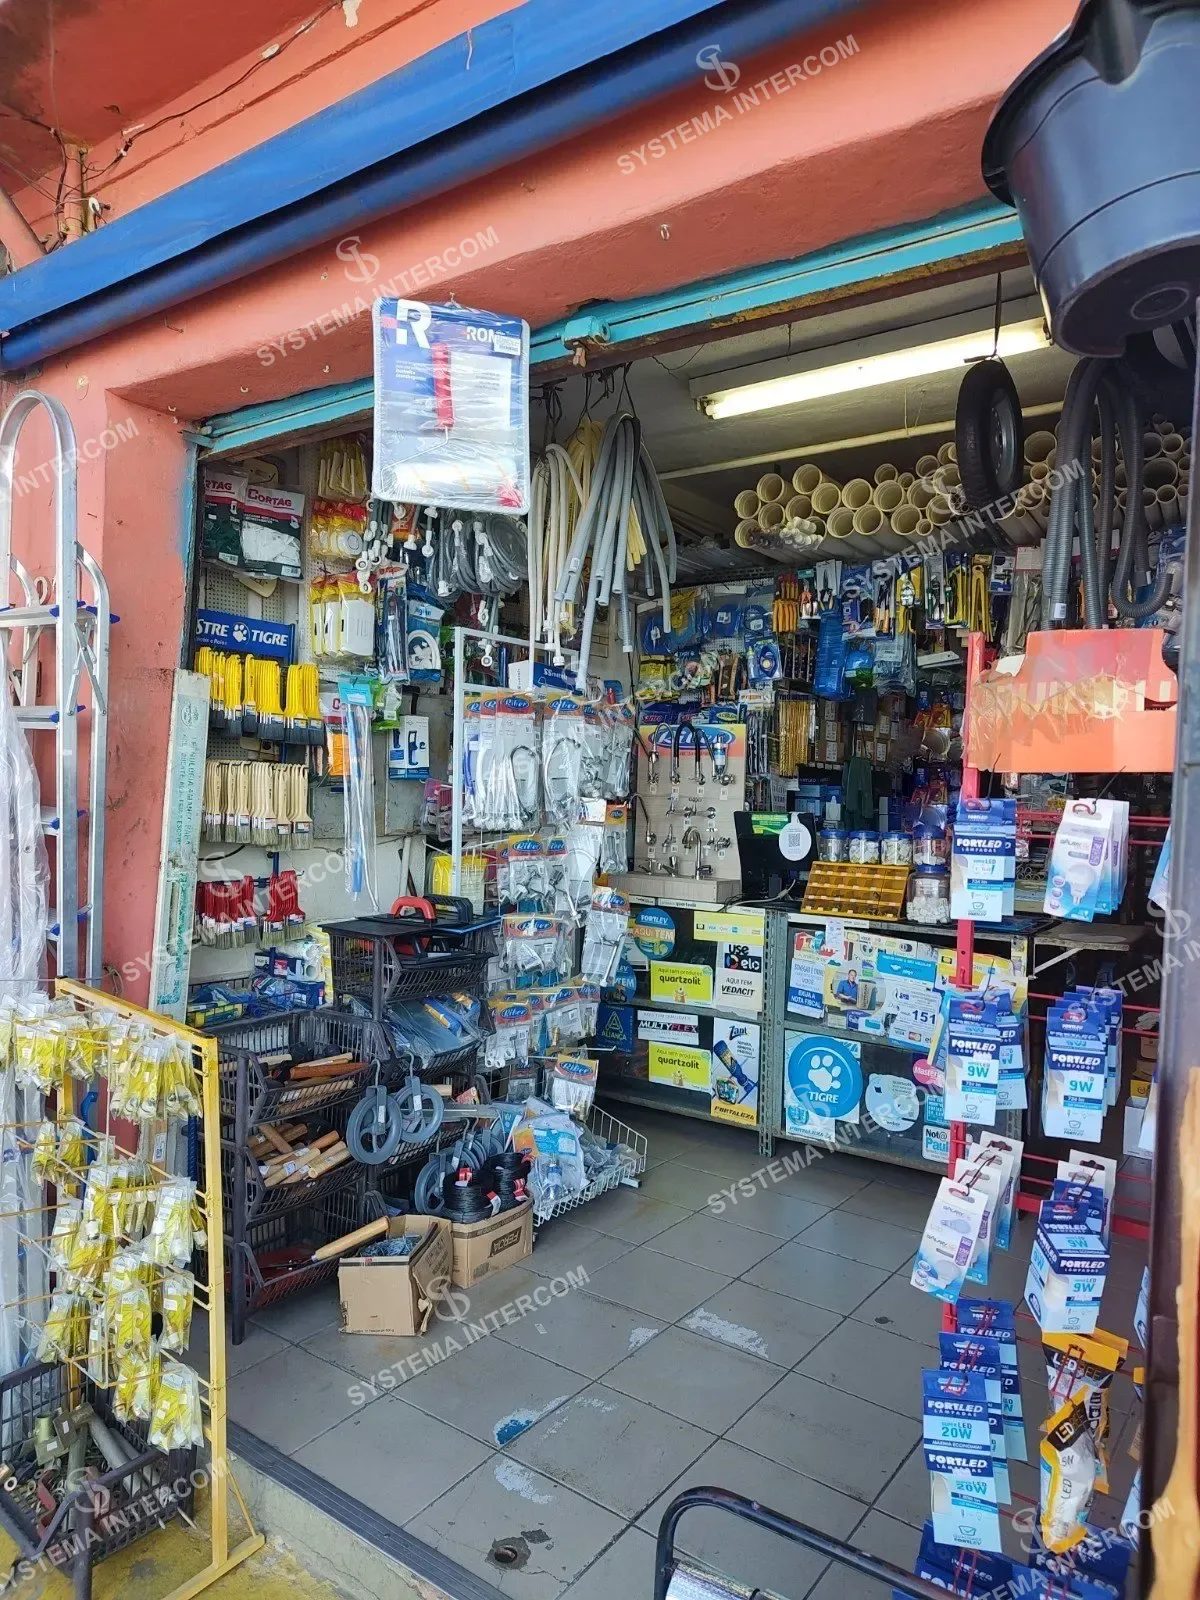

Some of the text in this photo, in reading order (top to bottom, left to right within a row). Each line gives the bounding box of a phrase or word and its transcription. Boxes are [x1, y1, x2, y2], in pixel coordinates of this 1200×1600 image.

[395, 298, 432, 348] R
[205, 480, 232, 490] RTAG
[248, 488, 291, 506] CORTAG
[252, 630, 288, 646] TIGRE
[957, 838, 1002, 848] FORTLED
[640, 914, 668, 925] FORTLEV
[634, 928, 674, 941] AQUI TEM
[729, 944, 749, 955] use
[741, 958, 760, 970] elo
[660, 975, 701, 985] quartzolit
[722, 985, 755, 996] VEDACIT
[502, 1007, 527, 1017] Riber
[912, 1009, 936, 1024] 151
[639, 1020, 697, 1033] MULTYFLEX
[602, 1031, 627, 1041] ALIANÇA
[951, 1039, 996, 1051] FORTLED
[658, 1057, 699, 1069] quartzolit
[1052, 1053, 1100, 1065] FORTLED
[967, 1066, 989, 1078] 9W
[1069, 1080, 1093, 1092] 9W
[809, 1091, 839, 1104] TIGRE
[1068, 1239, 1088, 1248] 9W
[1060, 1260, 1105, 1269] FORTLED
[1073, 1283, 1095, 1292] 9W
[928, 1400, 983, 1412] FORTLED
[941, 1427, 972, 1439] 20W
[928, 1454, 987, 1468] FORTLED
[956, 1484, 986, 1495] 20W
[1061, 1479, 1072, 1499] LED
